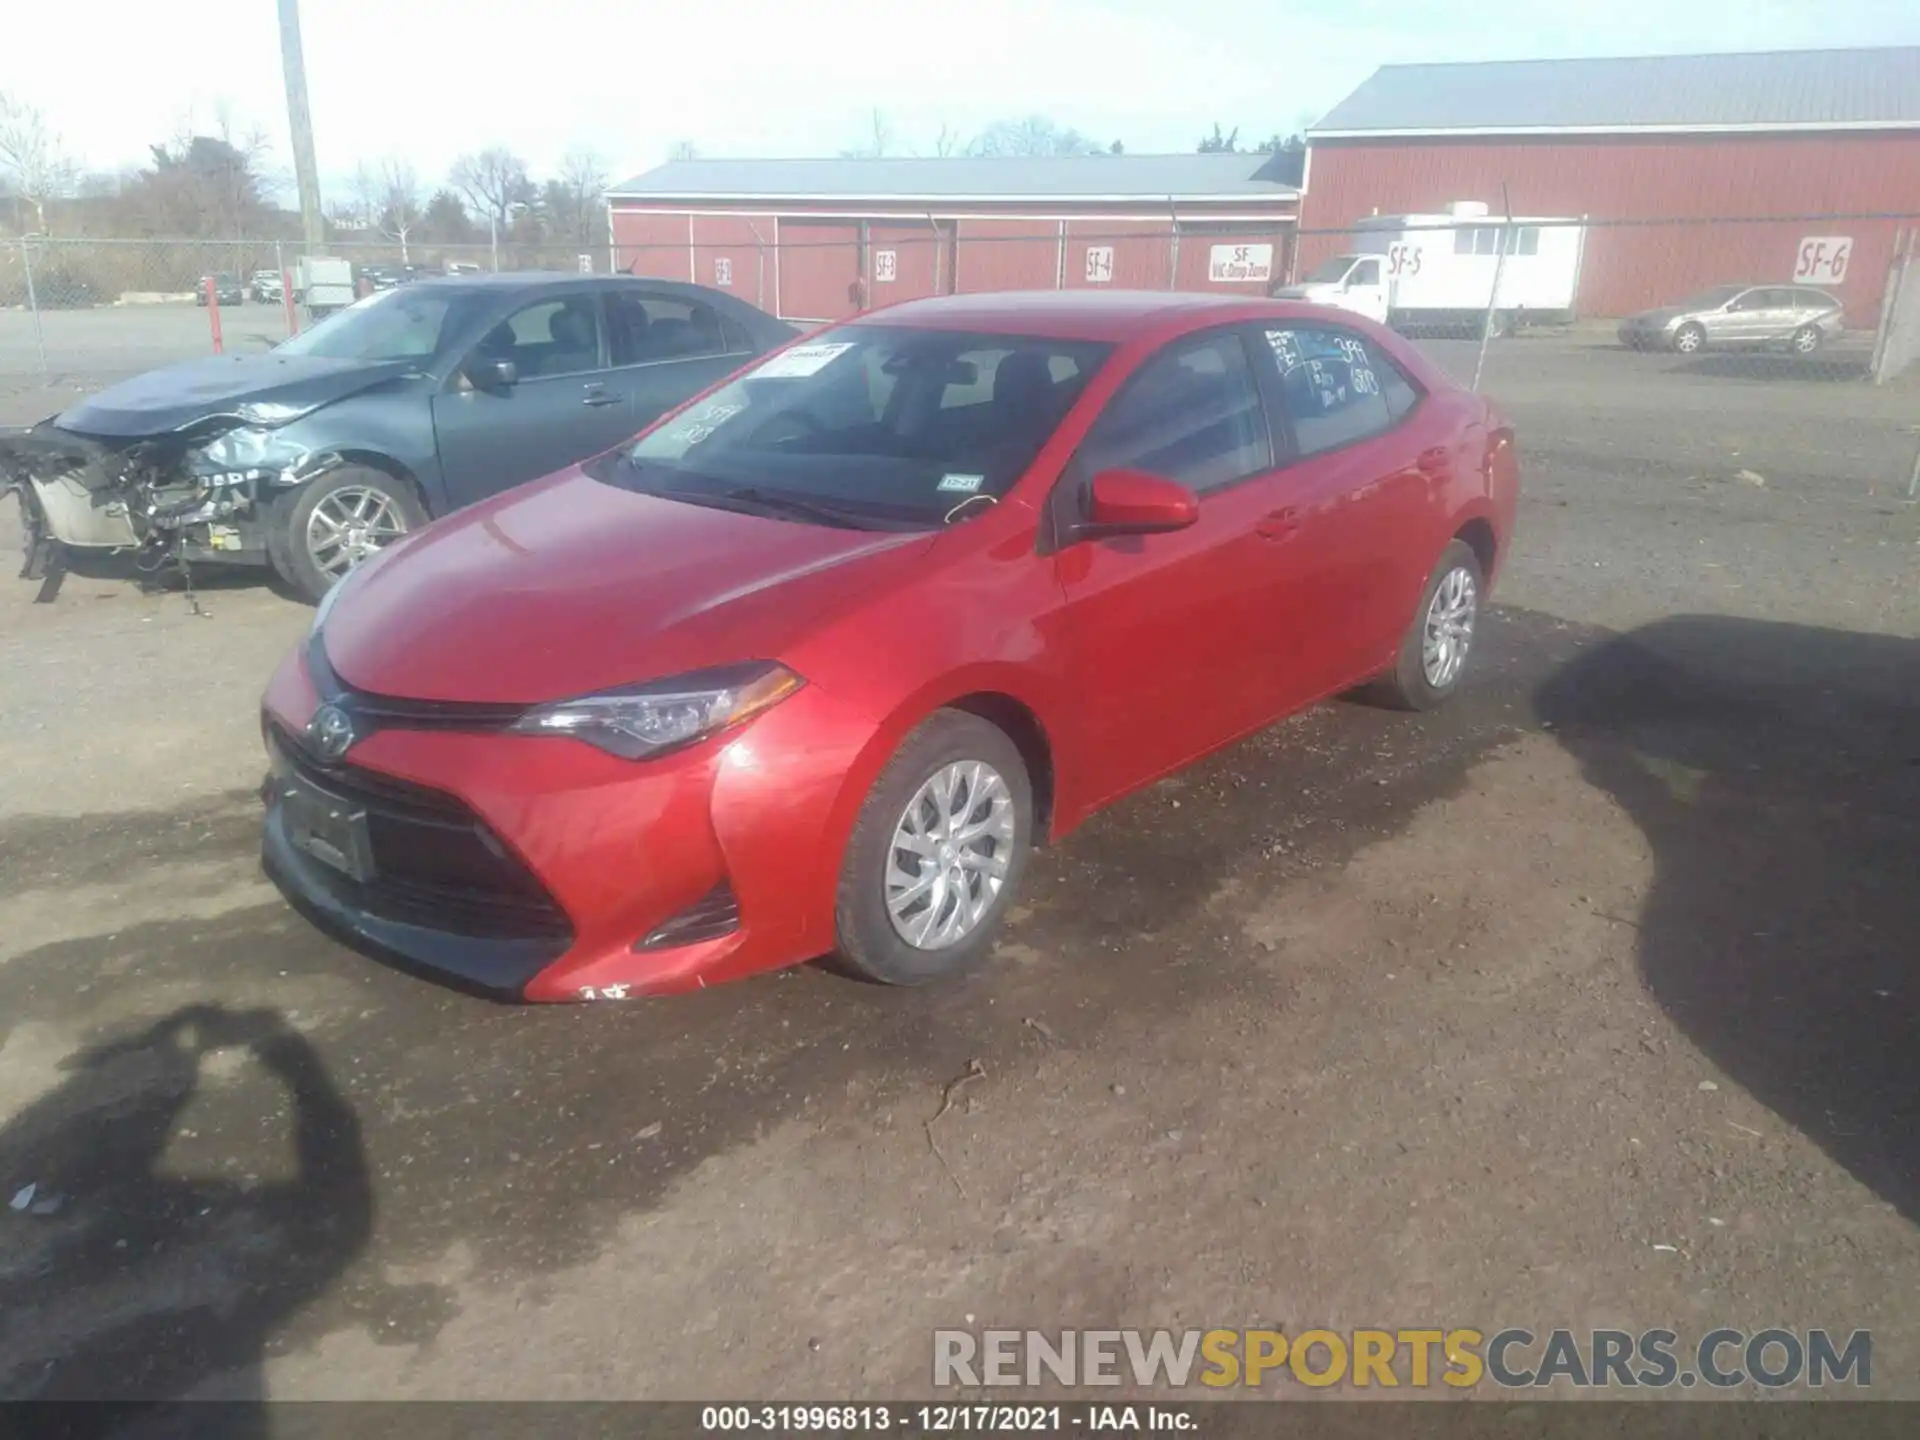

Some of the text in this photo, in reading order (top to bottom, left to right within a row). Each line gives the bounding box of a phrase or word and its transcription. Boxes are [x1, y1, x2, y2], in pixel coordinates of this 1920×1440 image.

[878, 254, 894, 277] SF-3
[1088, 251, 1110, 277] SF-4
[1233, 246, 1250, 262] SF
[1387, 245, 1422, 276] SF-5
[1797, 242, 1847, 277] SF-6
